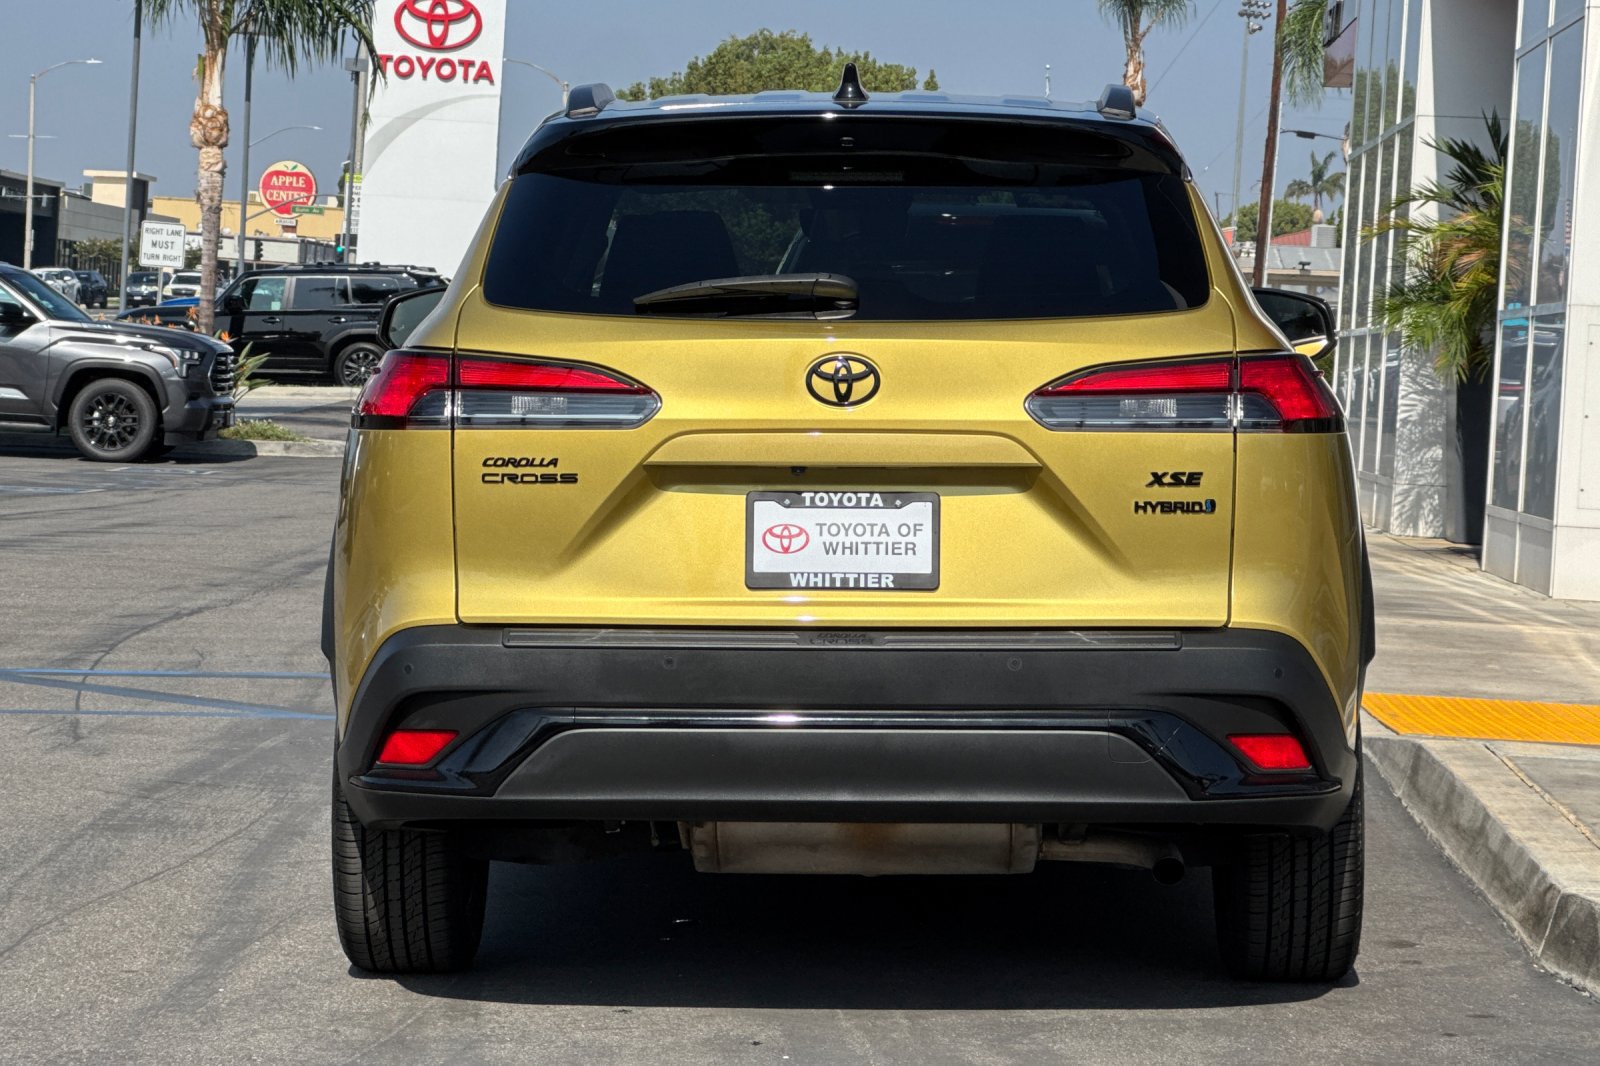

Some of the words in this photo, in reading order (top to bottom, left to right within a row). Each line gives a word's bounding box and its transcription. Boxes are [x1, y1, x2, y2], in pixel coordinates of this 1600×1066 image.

[378, 54, 495, 86] TOYOTA
[270, 175, 306, 187] APPLE
[266, 189, 308, 203] CENTER
[145, 227, 164, 235] RIGHT
[166, 229, 182, 237] LANE
[151, 239, 175, 250] MUST
[143, 252, 160, 260] TURN
[162, 254, 182, 263] RIGHT
[482, 457, 559, 468] COROLLA
[481, 473, 579, 484] CROSS
[1145, 472, 1204, 488] XSE
[801, 492, 884, 507] TOYOTA
[1134, 501, 1204, 515] HYBRID
[815, 523, 890, 538] TOYOTA
[897, 523, 924, 538] OF
[823, 541, 917, 556] WHITTIER
[789, 573, 895, 588] WHITTIER
